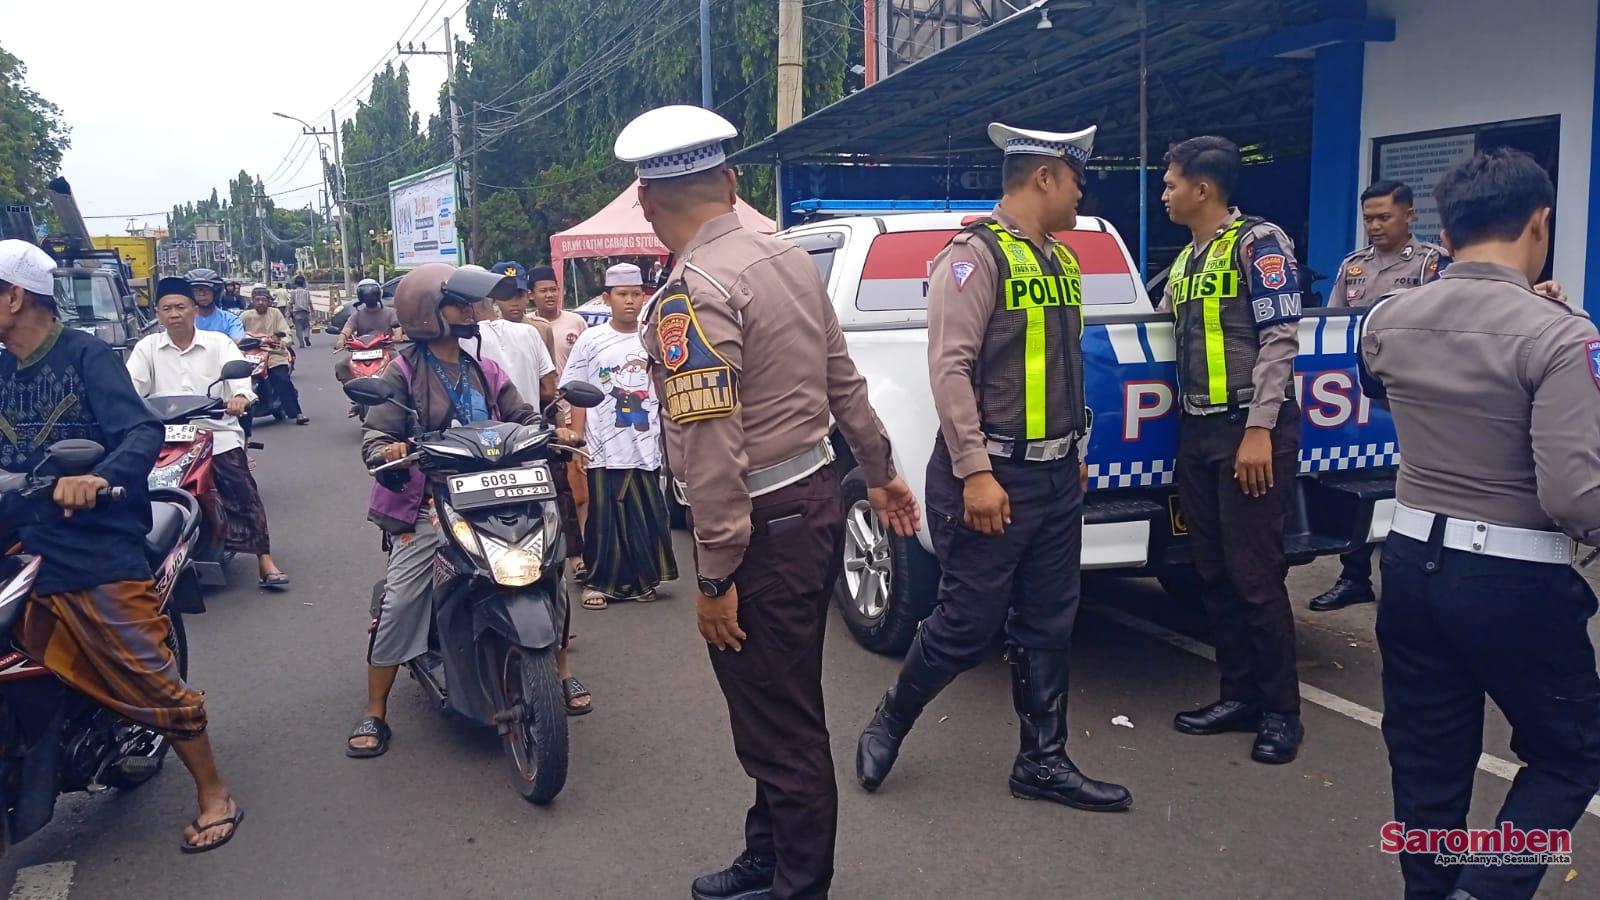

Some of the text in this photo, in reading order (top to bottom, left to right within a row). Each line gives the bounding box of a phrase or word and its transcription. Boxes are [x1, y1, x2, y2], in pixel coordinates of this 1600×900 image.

[561, 239, 582, 252] BANK
[604, 236, 635, 249] CABANG
[635, 236, 665, 248] SITUB
[1206, 260, 1226, 270] POLRI
[1011, 278, 1082, 307] POLIS
[1172, 272, 1232, 304] OLISI
[666, 371, 720, 397] ANIT
[486, 448, 500, 456] EVA
[455, 470, 544, 492] P 6089 D
[155, 552, 183, 594] REVO
